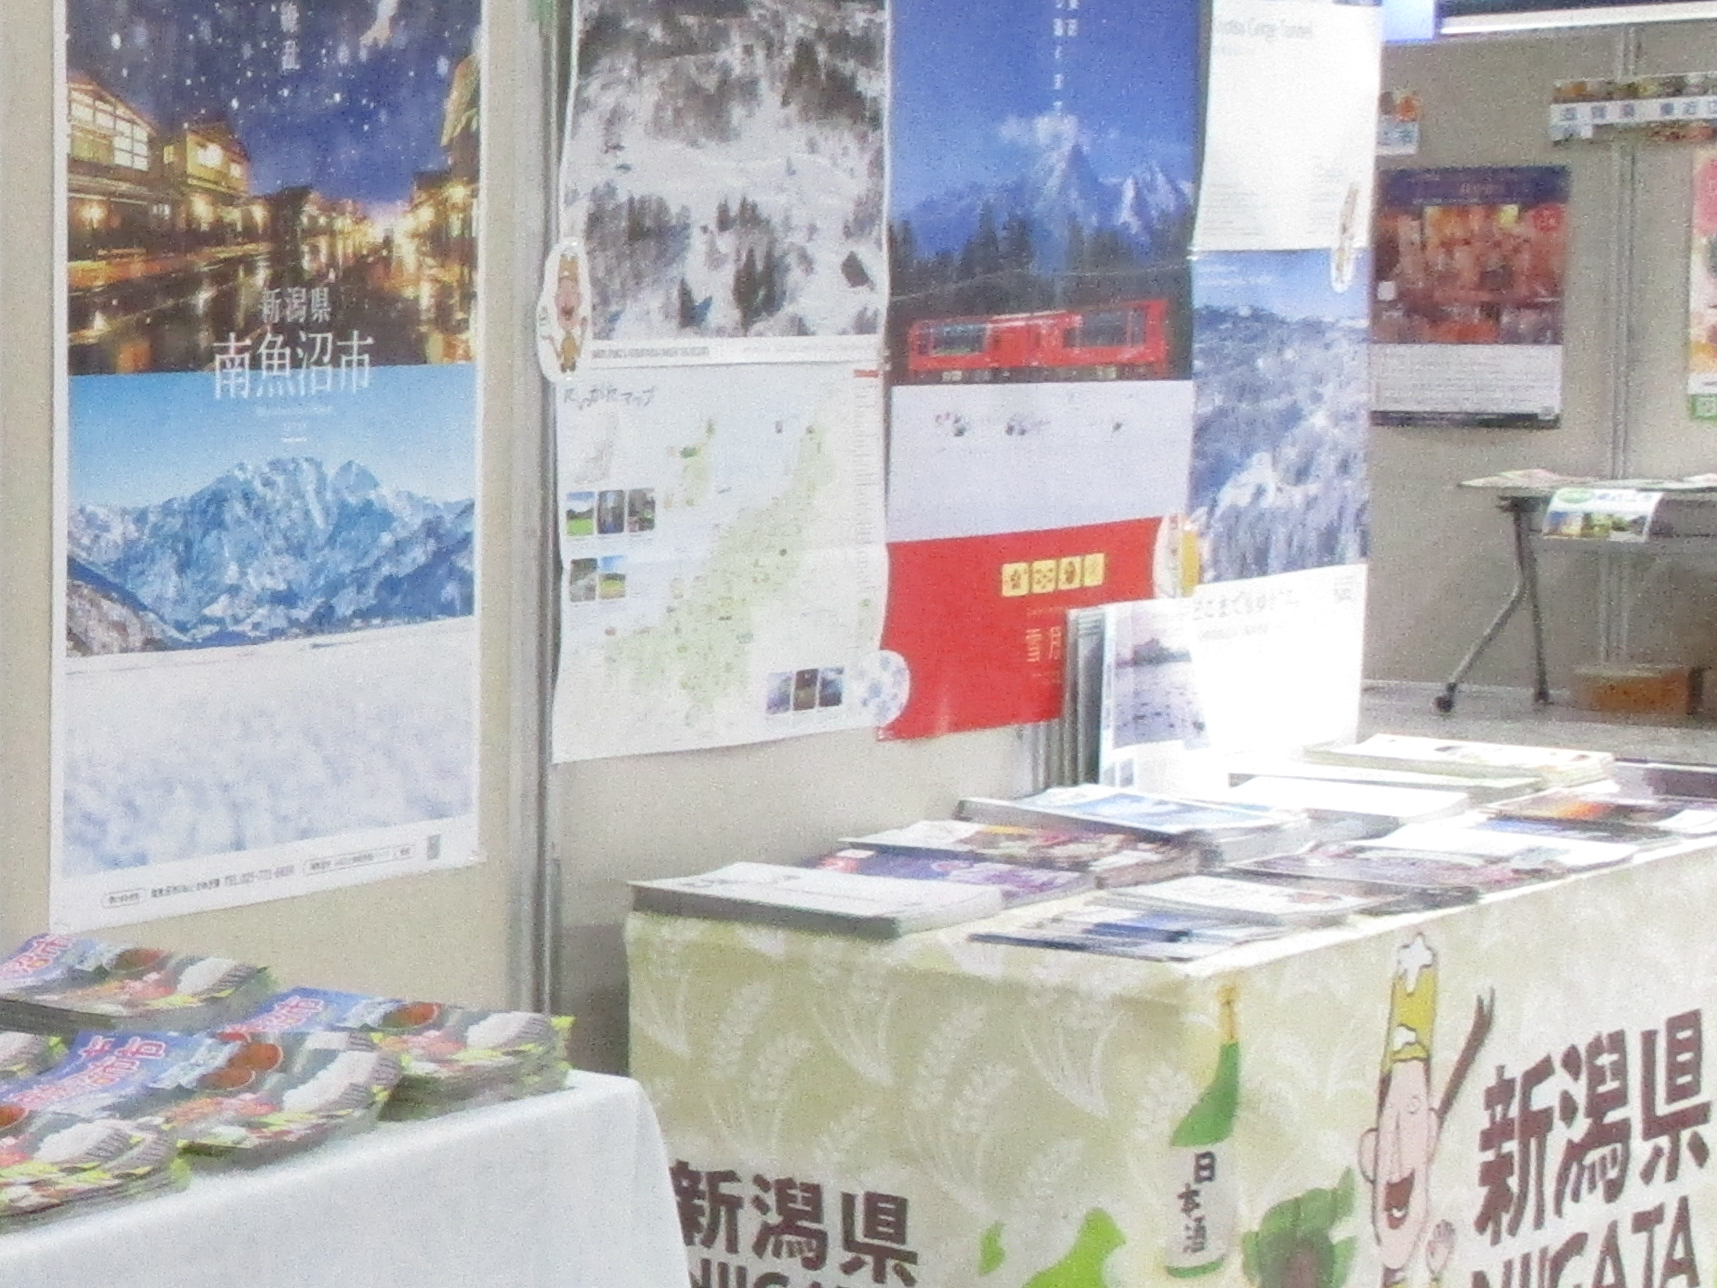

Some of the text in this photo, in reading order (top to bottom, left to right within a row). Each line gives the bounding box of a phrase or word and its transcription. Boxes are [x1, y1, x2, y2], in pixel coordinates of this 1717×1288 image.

[259, 286, 332, 324] 新潟県
[213, 328, 375, 400] 南魚沼市
[1476, 1009, 1712, 1248] 新潟県
[671, 1160, 919, 1288] 新潟県
